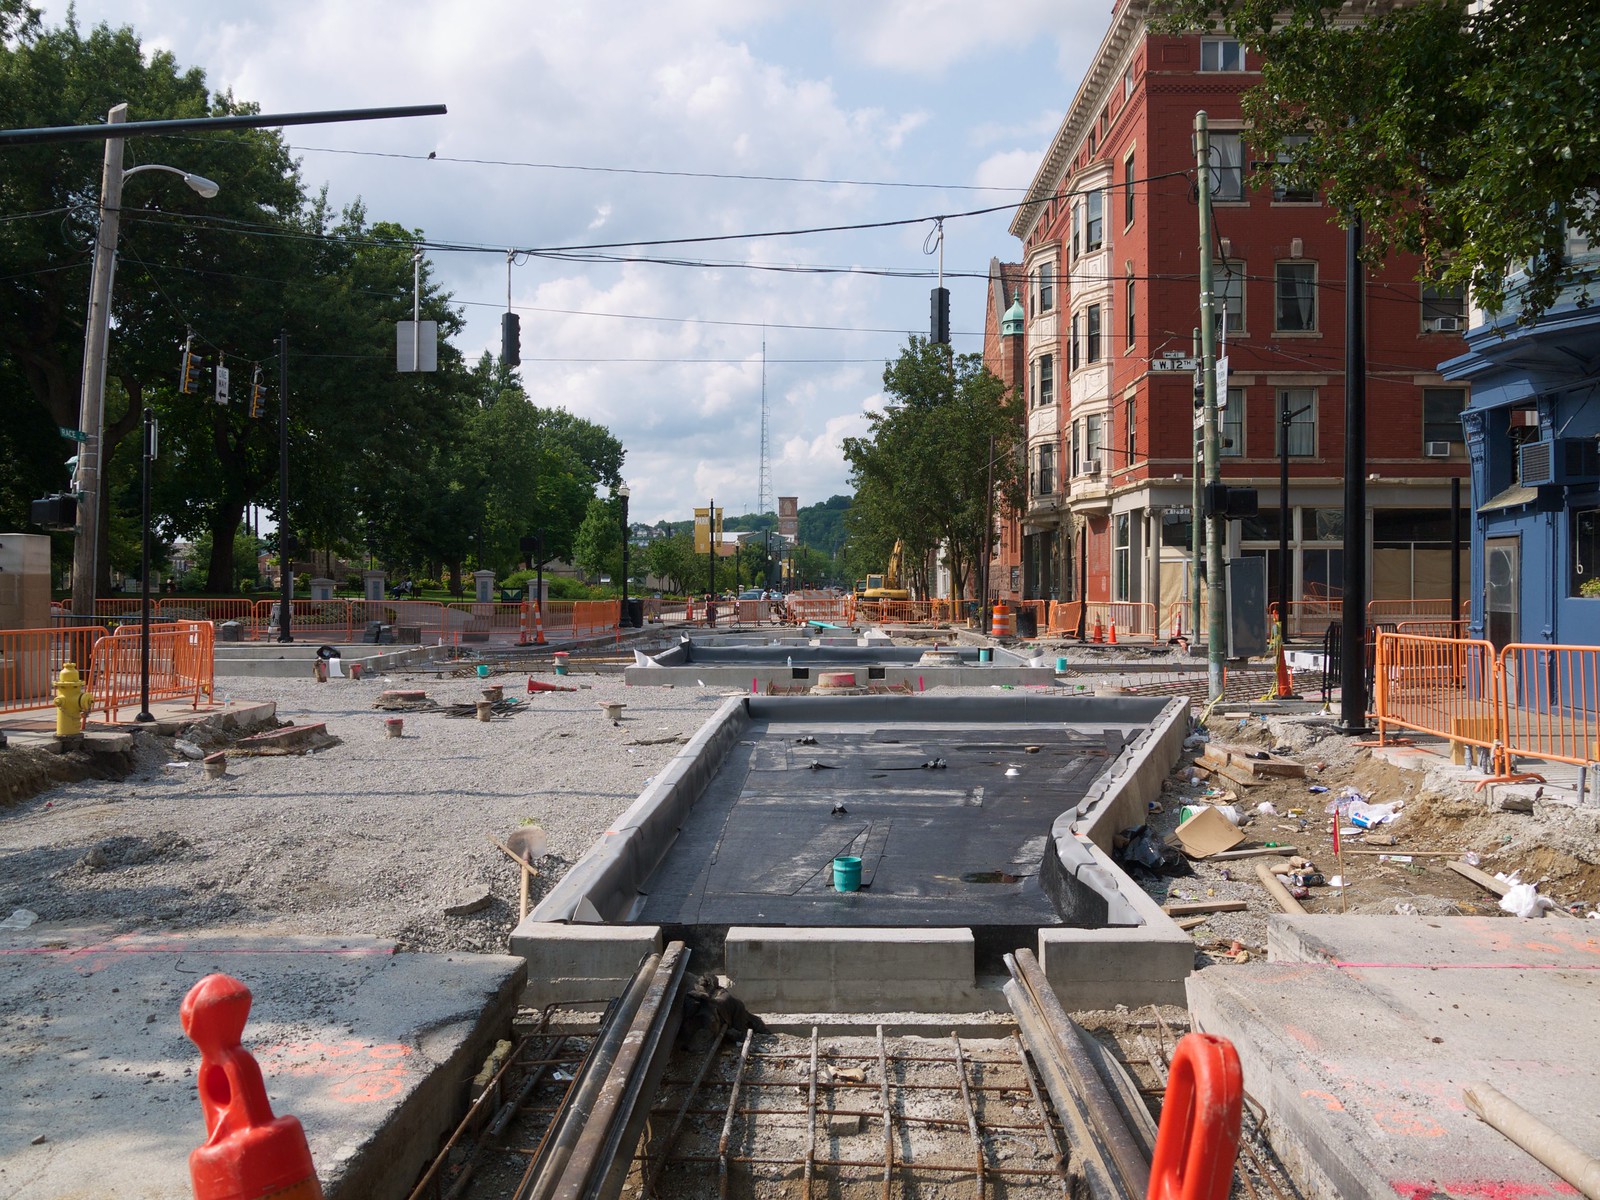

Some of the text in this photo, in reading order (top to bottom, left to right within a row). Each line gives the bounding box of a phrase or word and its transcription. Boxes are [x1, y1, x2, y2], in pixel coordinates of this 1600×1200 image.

[1171, 360, 1191, 369] 12TH
[218, 369, 227, 380] ONE
[218, 380, 227, 389] WAY
[61, 428, 77, 439] RACE
